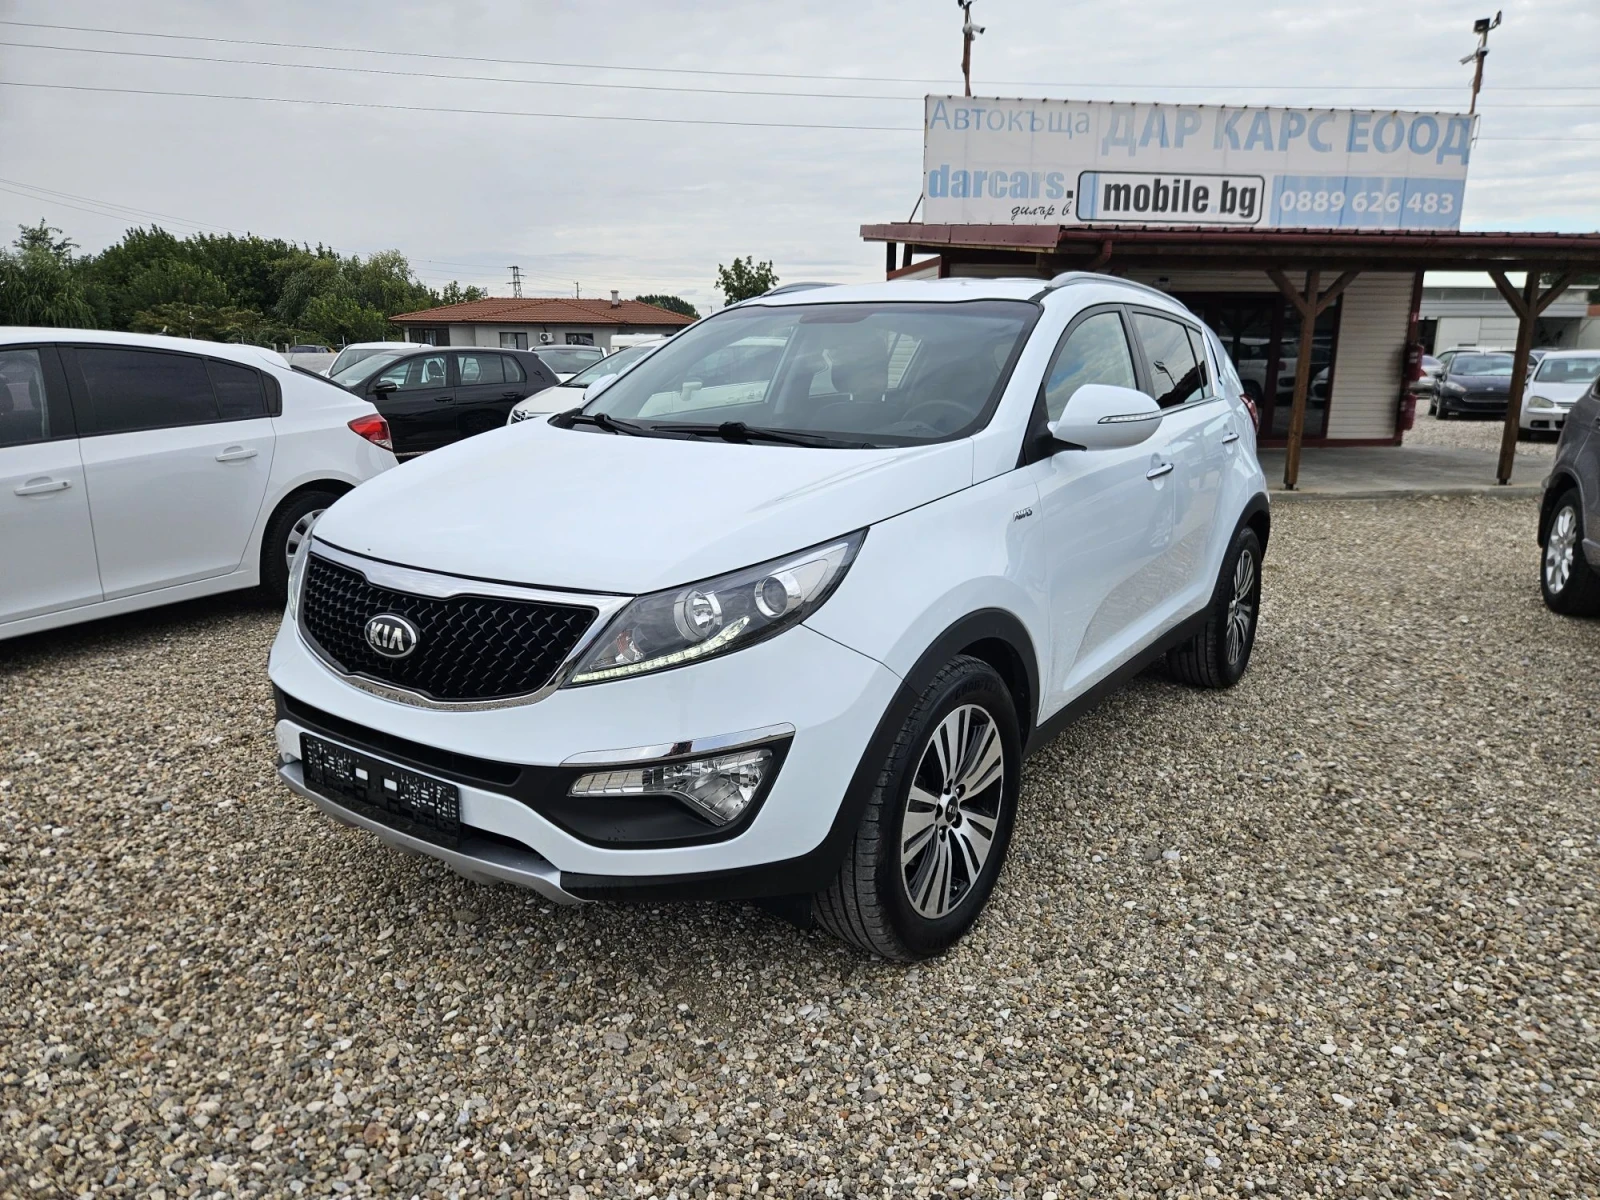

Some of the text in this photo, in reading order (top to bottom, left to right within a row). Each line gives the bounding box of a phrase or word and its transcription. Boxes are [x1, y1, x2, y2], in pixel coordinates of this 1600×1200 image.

[929, 100, 1472, 165] Автокъща ДАР КАРС ЕООД
[1103, 177, 1257, 219] mobile.bg
[1280, 190, 1454, 214] 0889 626 483
[369, 621, 404, 651] KIA
